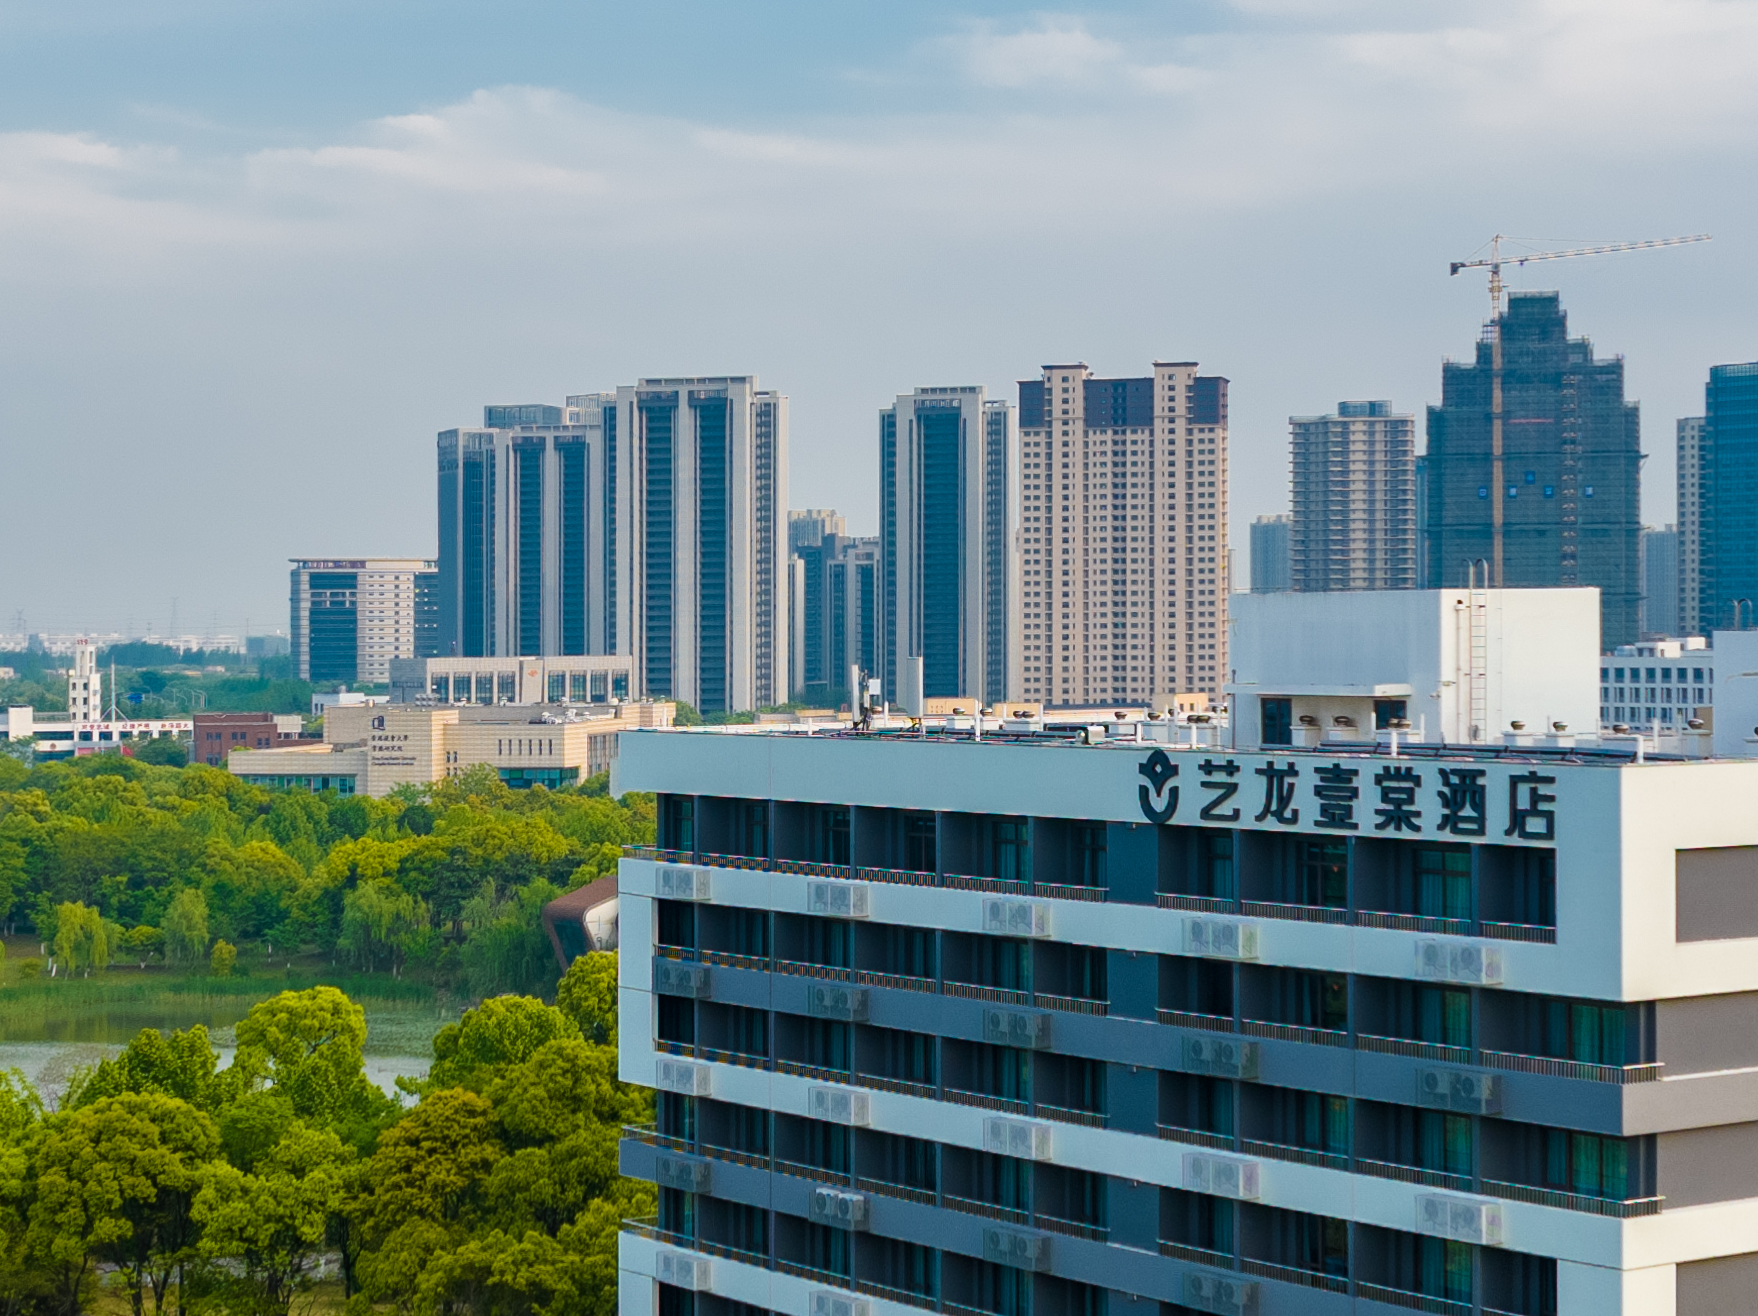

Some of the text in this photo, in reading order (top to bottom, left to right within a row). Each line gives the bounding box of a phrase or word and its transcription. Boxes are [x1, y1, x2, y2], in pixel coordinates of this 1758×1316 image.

[1198, 759, 1556, 840] 艺龙壹棠酒店
